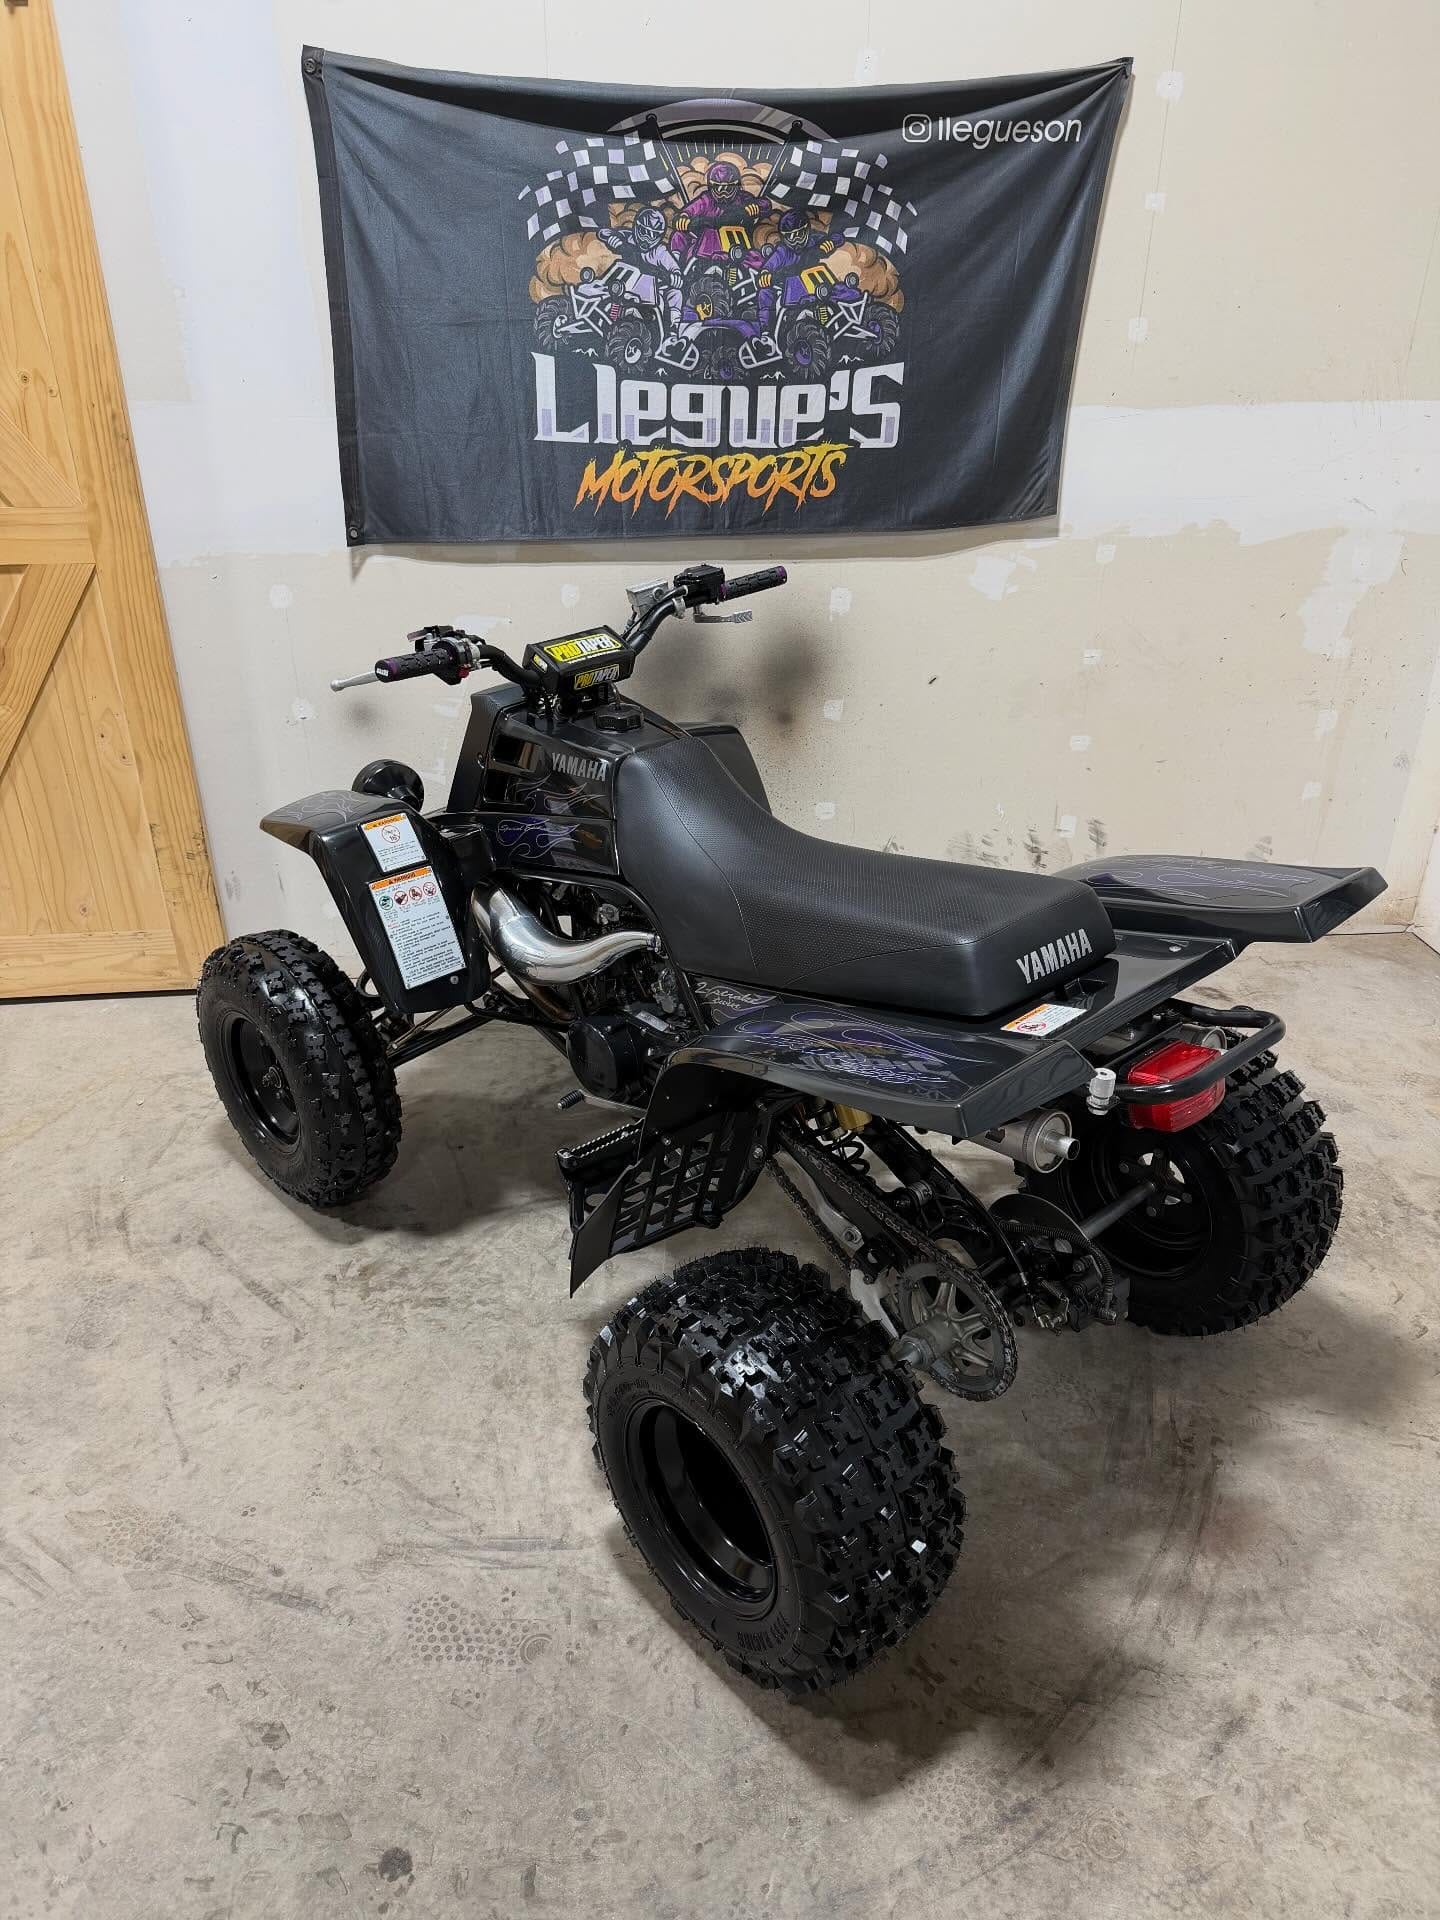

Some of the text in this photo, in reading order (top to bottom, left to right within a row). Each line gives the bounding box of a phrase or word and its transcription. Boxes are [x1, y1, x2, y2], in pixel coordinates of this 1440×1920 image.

[938, 117, 1082, 149] llegueson
[573, 441, 853, 520] MOTORSPORTS
[552, 752, 607, 782] YAMAHA
[1016, 928, 1092, 984] YAMAHA
